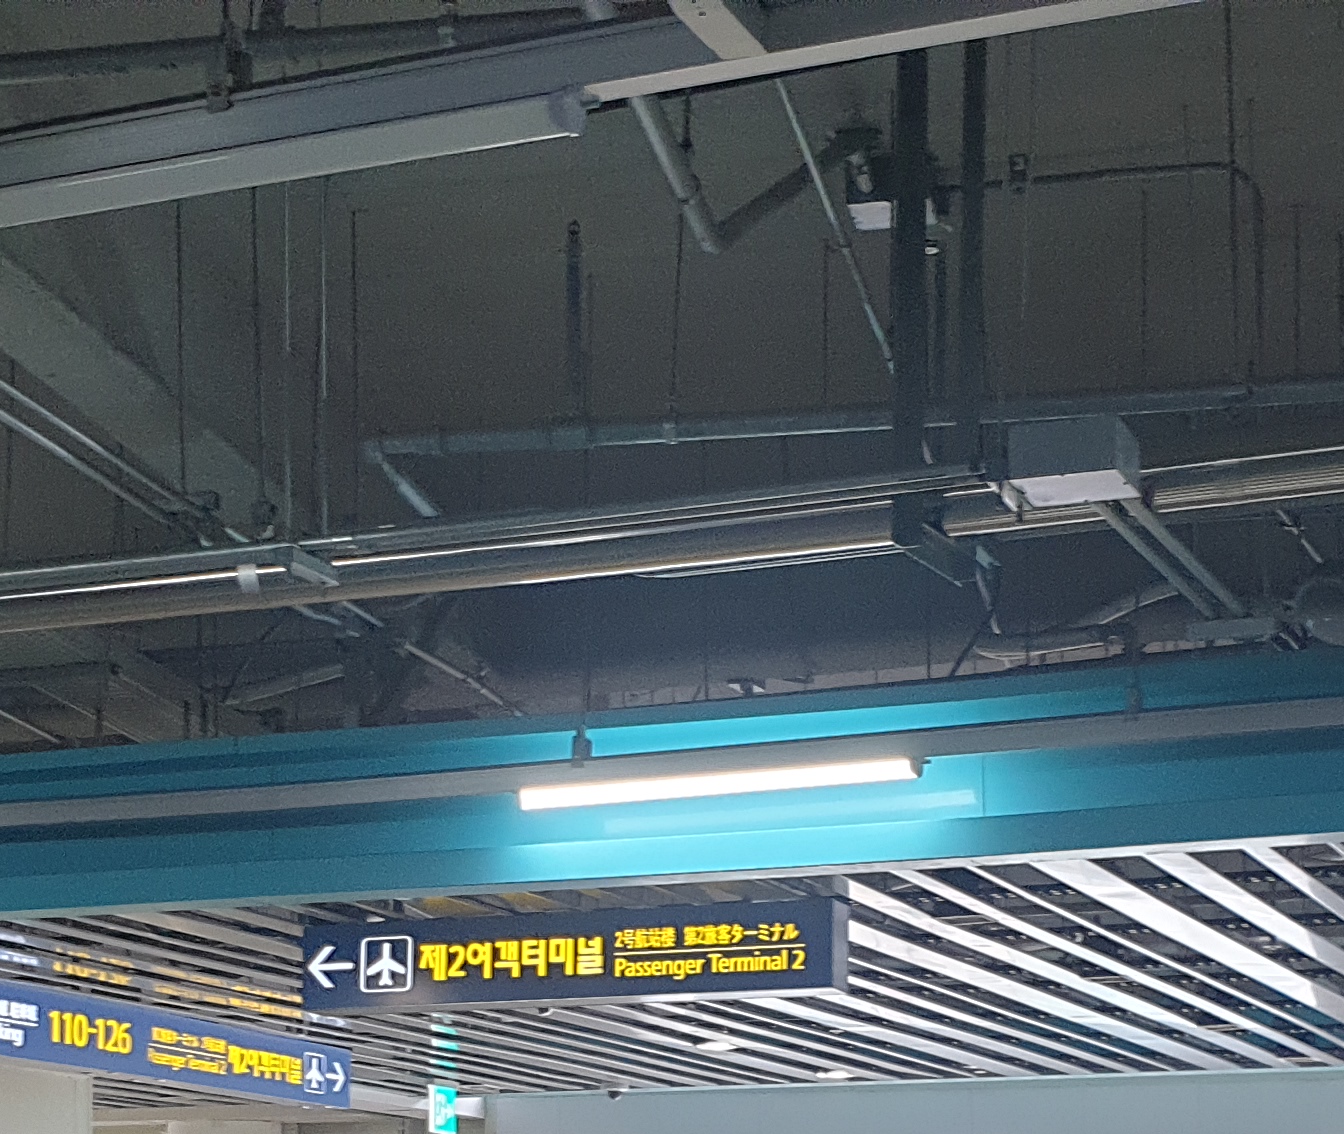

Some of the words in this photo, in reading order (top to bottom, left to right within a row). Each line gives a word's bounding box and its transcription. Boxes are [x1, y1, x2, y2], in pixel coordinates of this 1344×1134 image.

[419, 937, 605, 981] 제2여객터미널
[613, 958, 706, 980] Passenger
[706, 950, 789, 974] Terminal
[791, 950, 806, 970] 2
[49, 1010, 133, 1055] 110-126
[228, 1045, 303, 1085] 제2여객터미널
